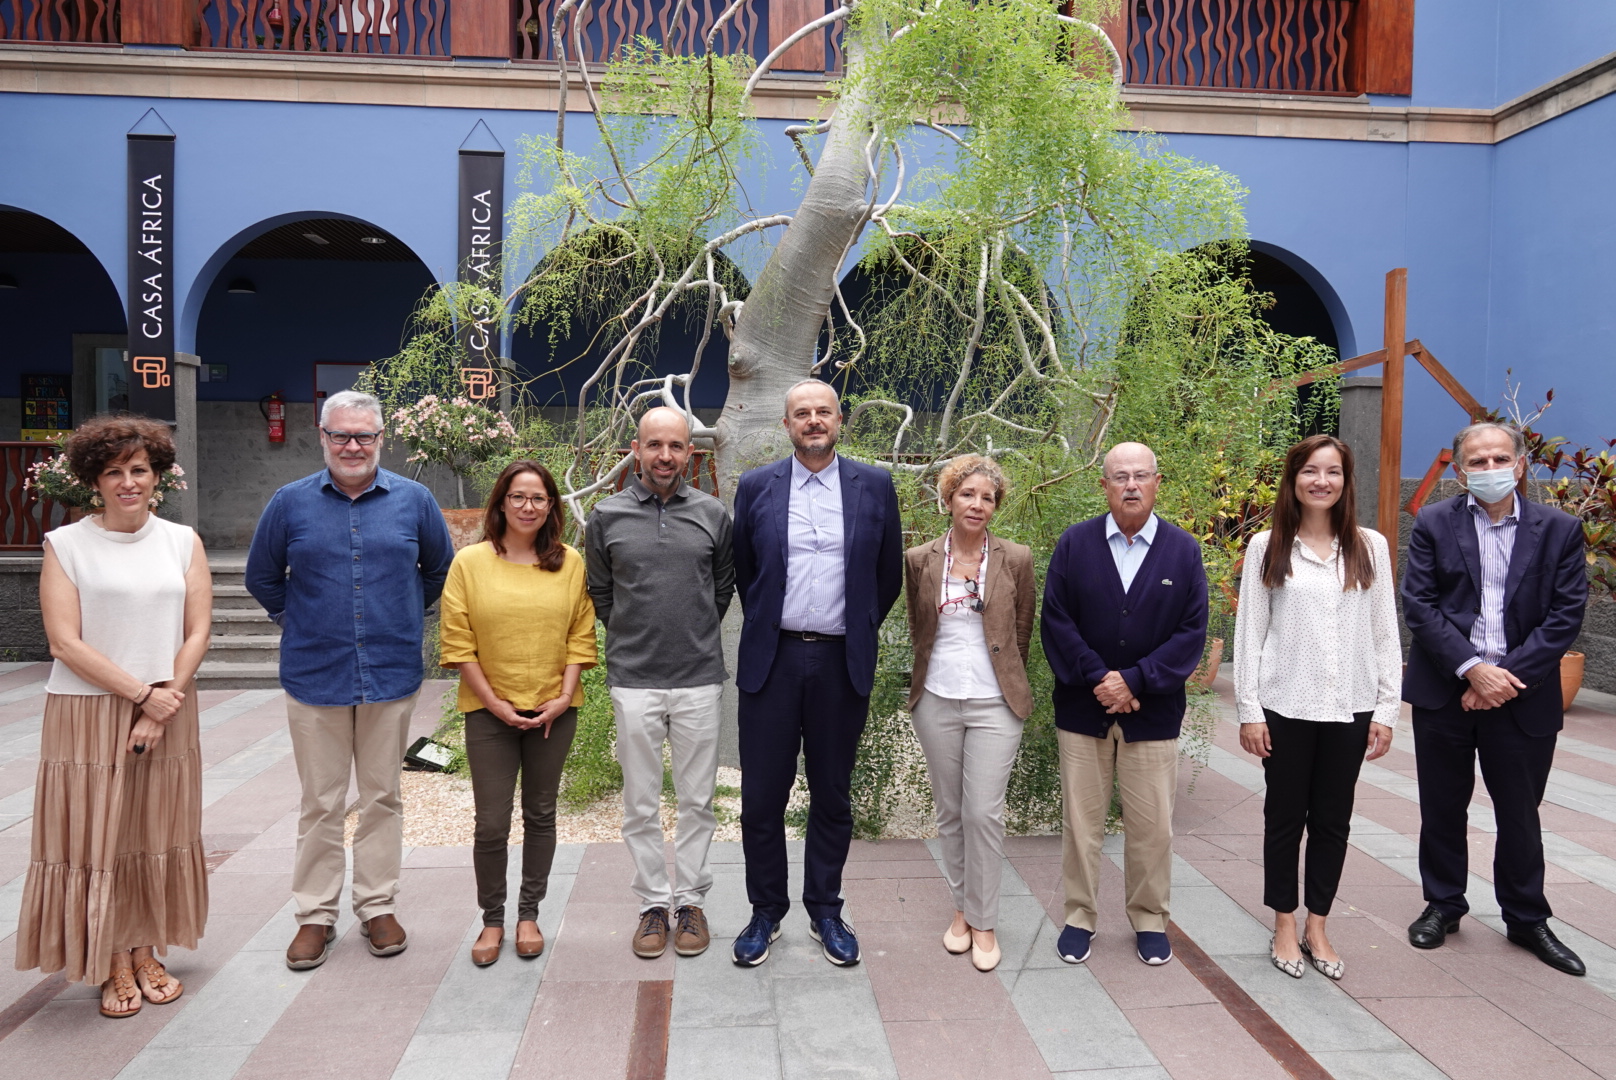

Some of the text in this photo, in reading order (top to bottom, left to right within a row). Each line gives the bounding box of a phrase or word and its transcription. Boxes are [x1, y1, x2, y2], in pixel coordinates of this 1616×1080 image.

[137, 174, 163, 339] CASA ÁFRICA
[467, 189, 491, 278] ÁFRICA
